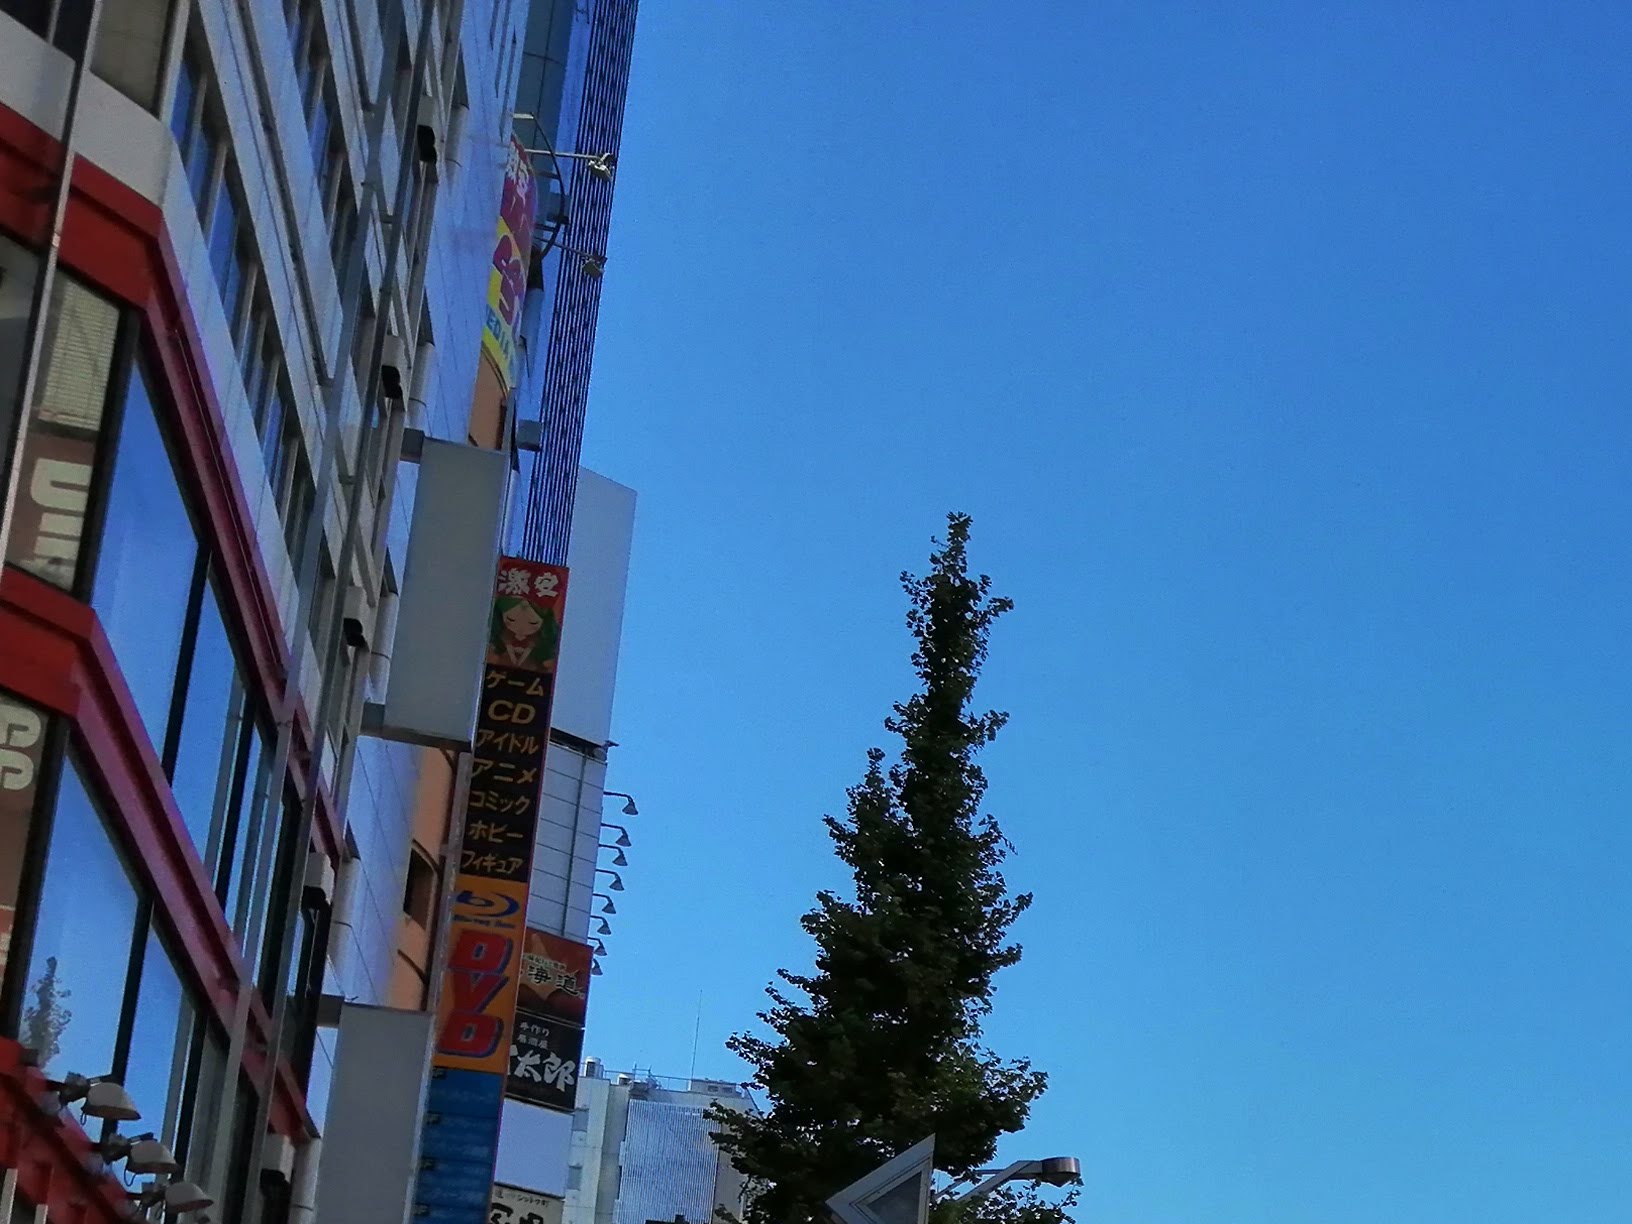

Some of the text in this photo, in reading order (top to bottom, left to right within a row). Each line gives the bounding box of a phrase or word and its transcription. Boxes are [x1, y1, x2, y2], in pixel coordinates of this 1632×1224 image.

[498, 567, 561, 598] 激安
[485, 669, 545, 697] ゲーム
[487, 700, 536, 725] CD
[475, 728, 539, 755] アイドル
[471, 756, 538, 785] アニメ
[469, 789, 531, 816] コミック
[468, 819, 525, 845] ホビー
[438, 930, 513, 1058] DVD
[510, 1045, 577, 1093] 太郎
